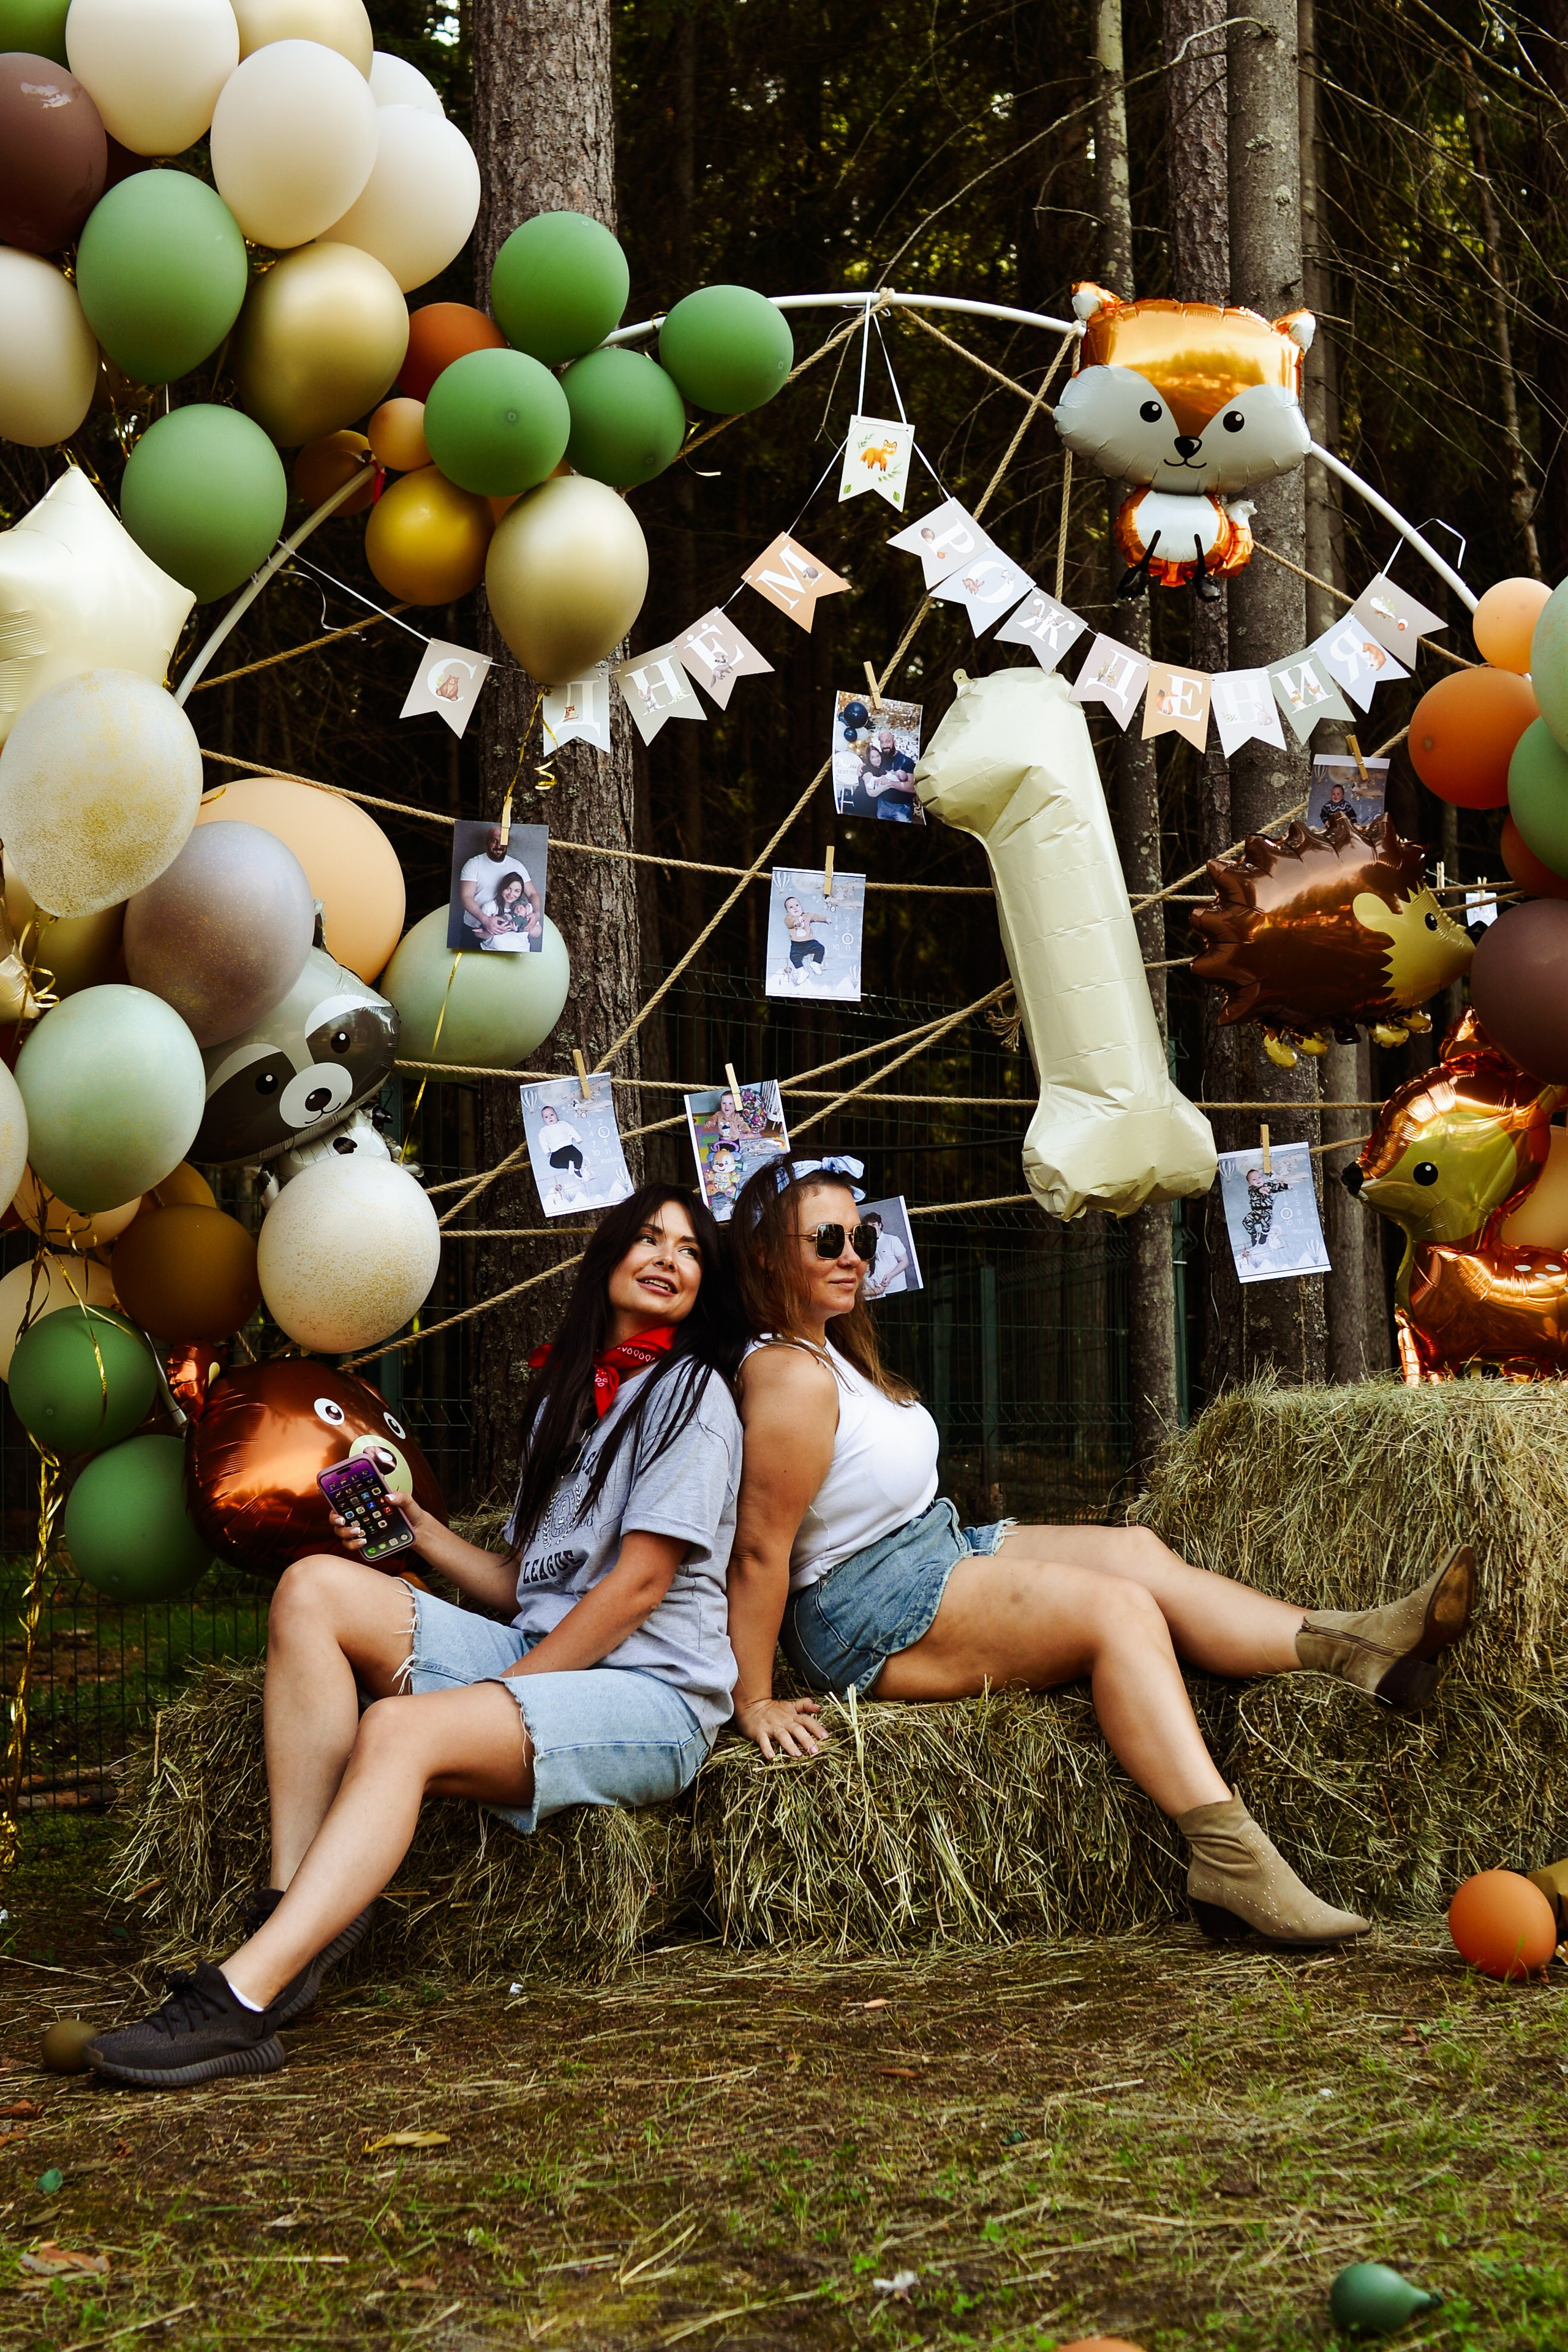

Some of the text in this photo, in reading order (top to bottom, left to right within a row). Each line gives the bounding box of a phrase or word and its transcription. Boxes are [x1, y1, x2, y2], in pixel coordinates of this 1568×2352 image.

[428, 543, 825, 737] С ДНЁМ
[522, 1550, 582, 1585] LEAGUE
